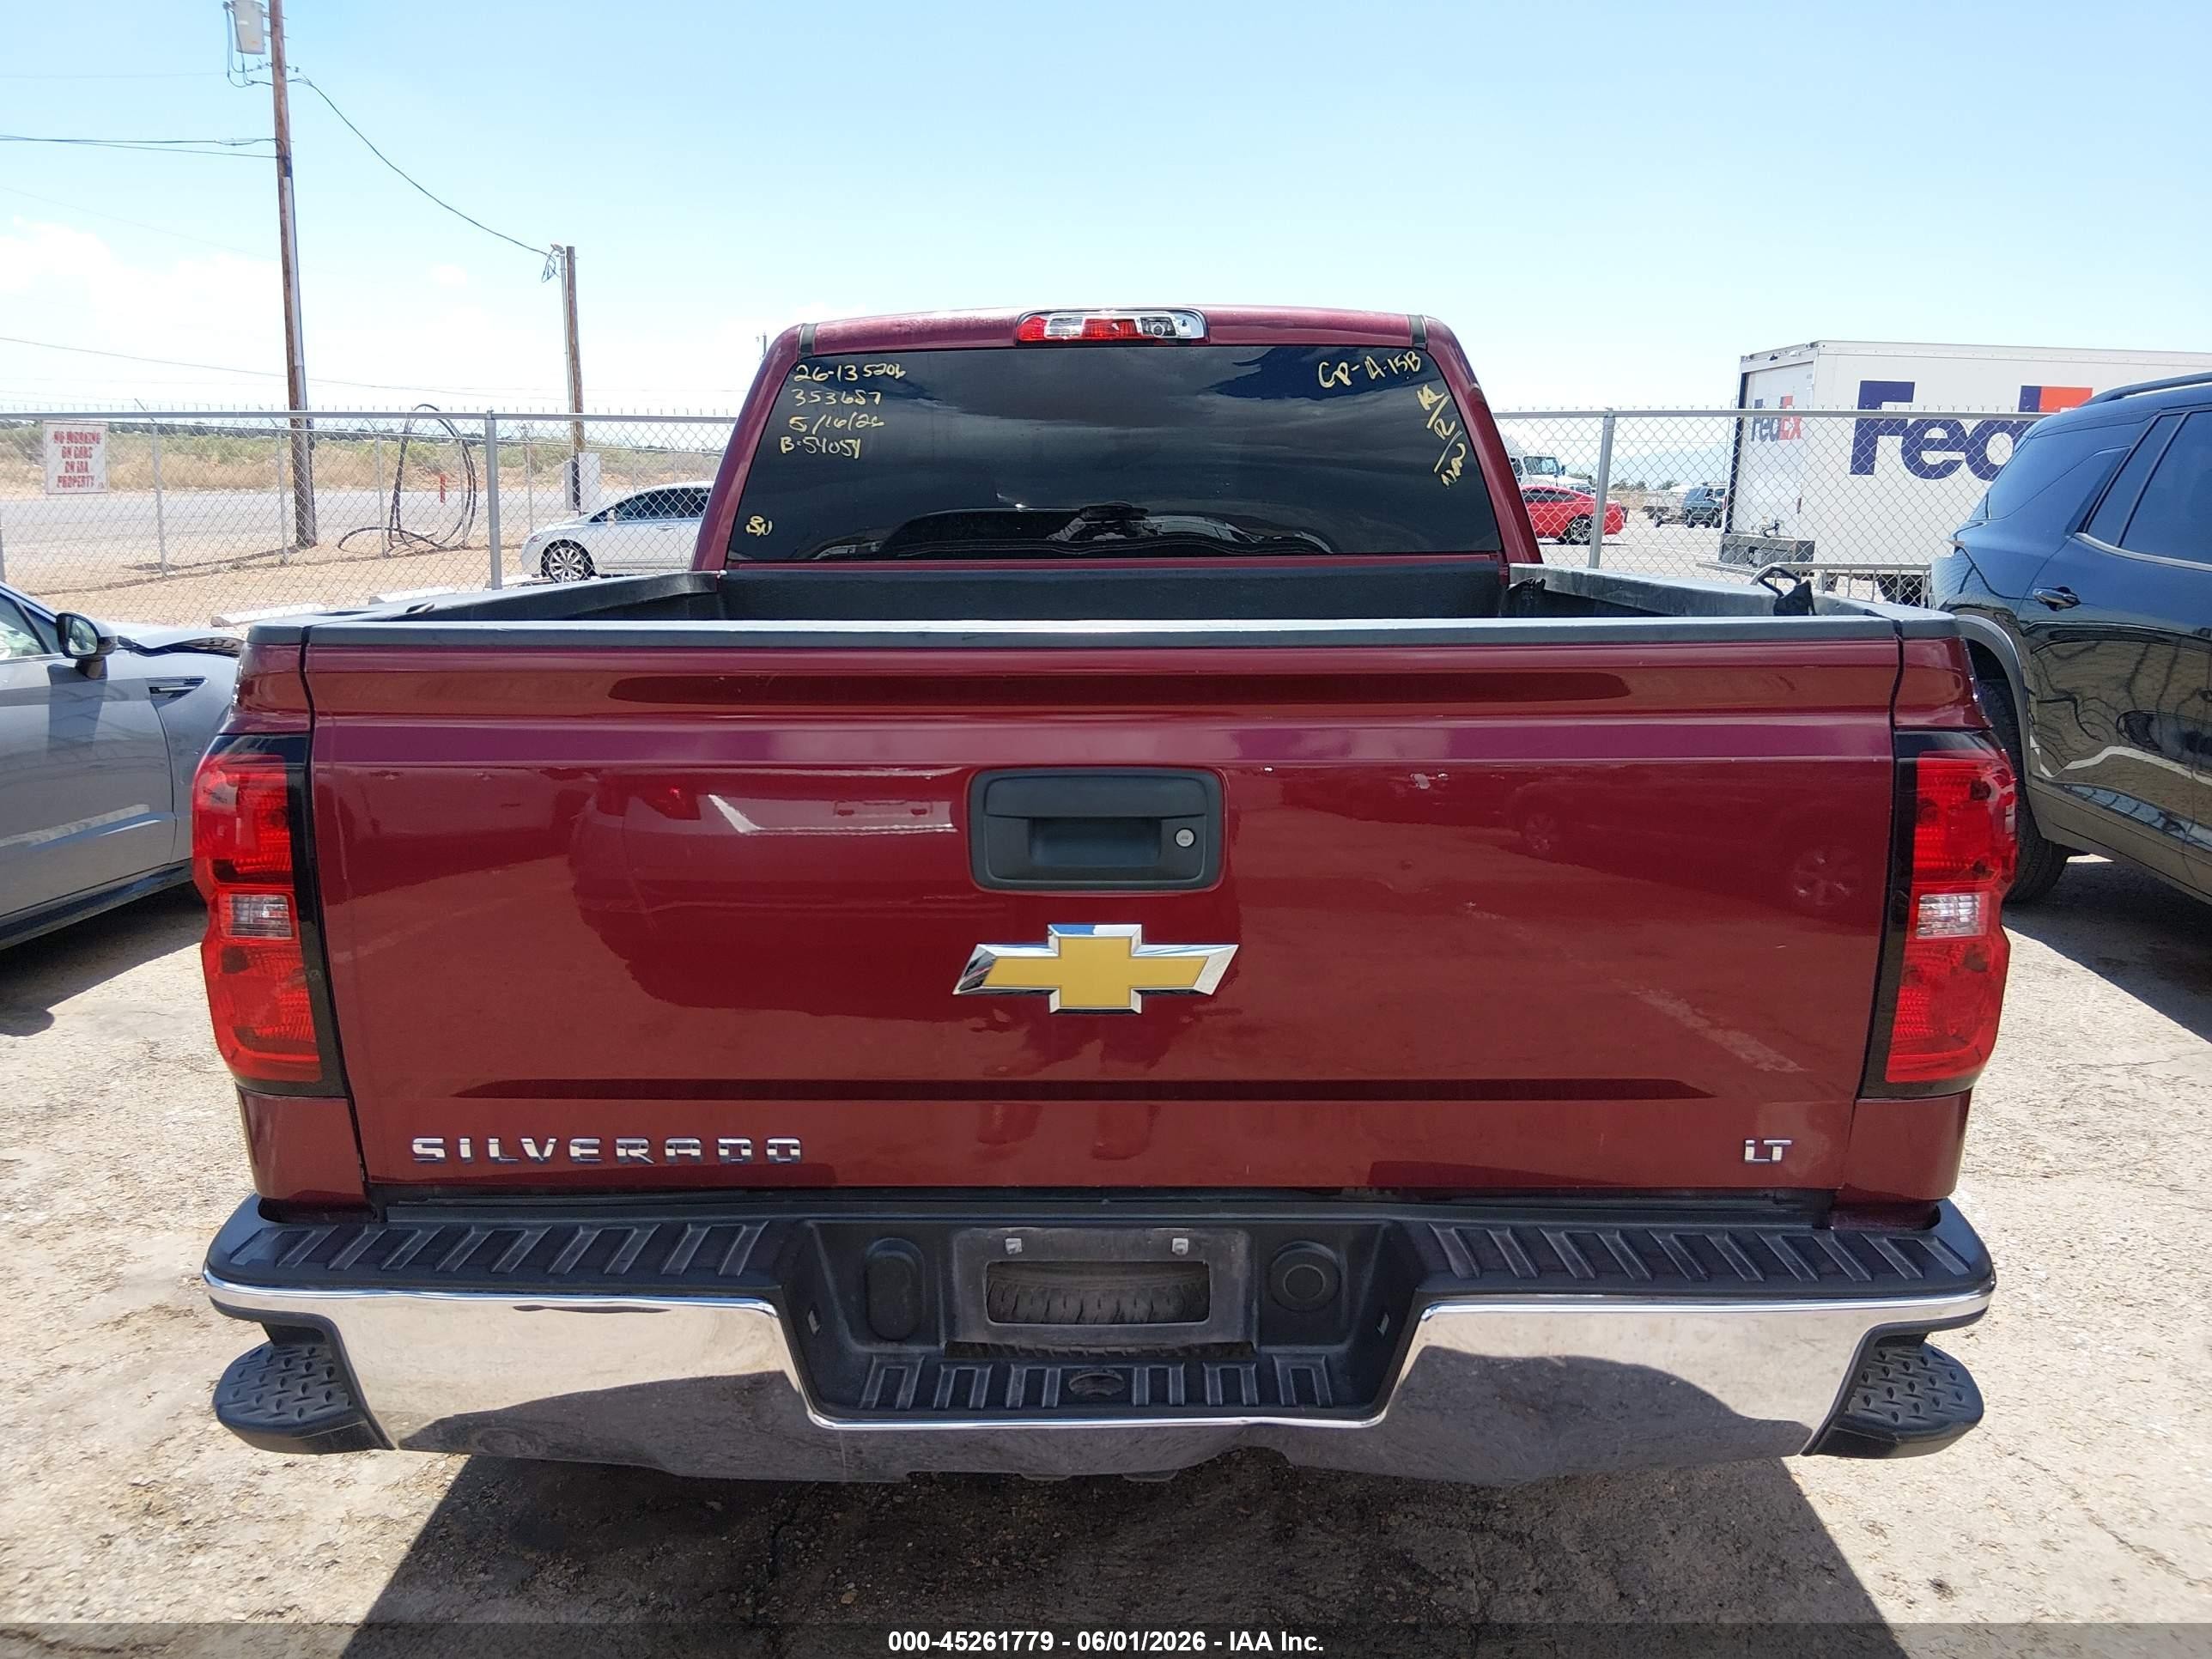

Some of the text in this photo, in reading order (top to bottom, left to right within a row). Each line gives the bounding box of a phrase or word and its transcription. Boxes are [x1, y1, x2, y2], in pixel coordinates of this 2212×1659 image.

[1751, 395, 1802, 442] FedEx
[57, 475, 94, 488] PROPERTY
[411, 1137, 802, 1164] SILVERADO
[1744, 1139, 1793, 1164] LT
